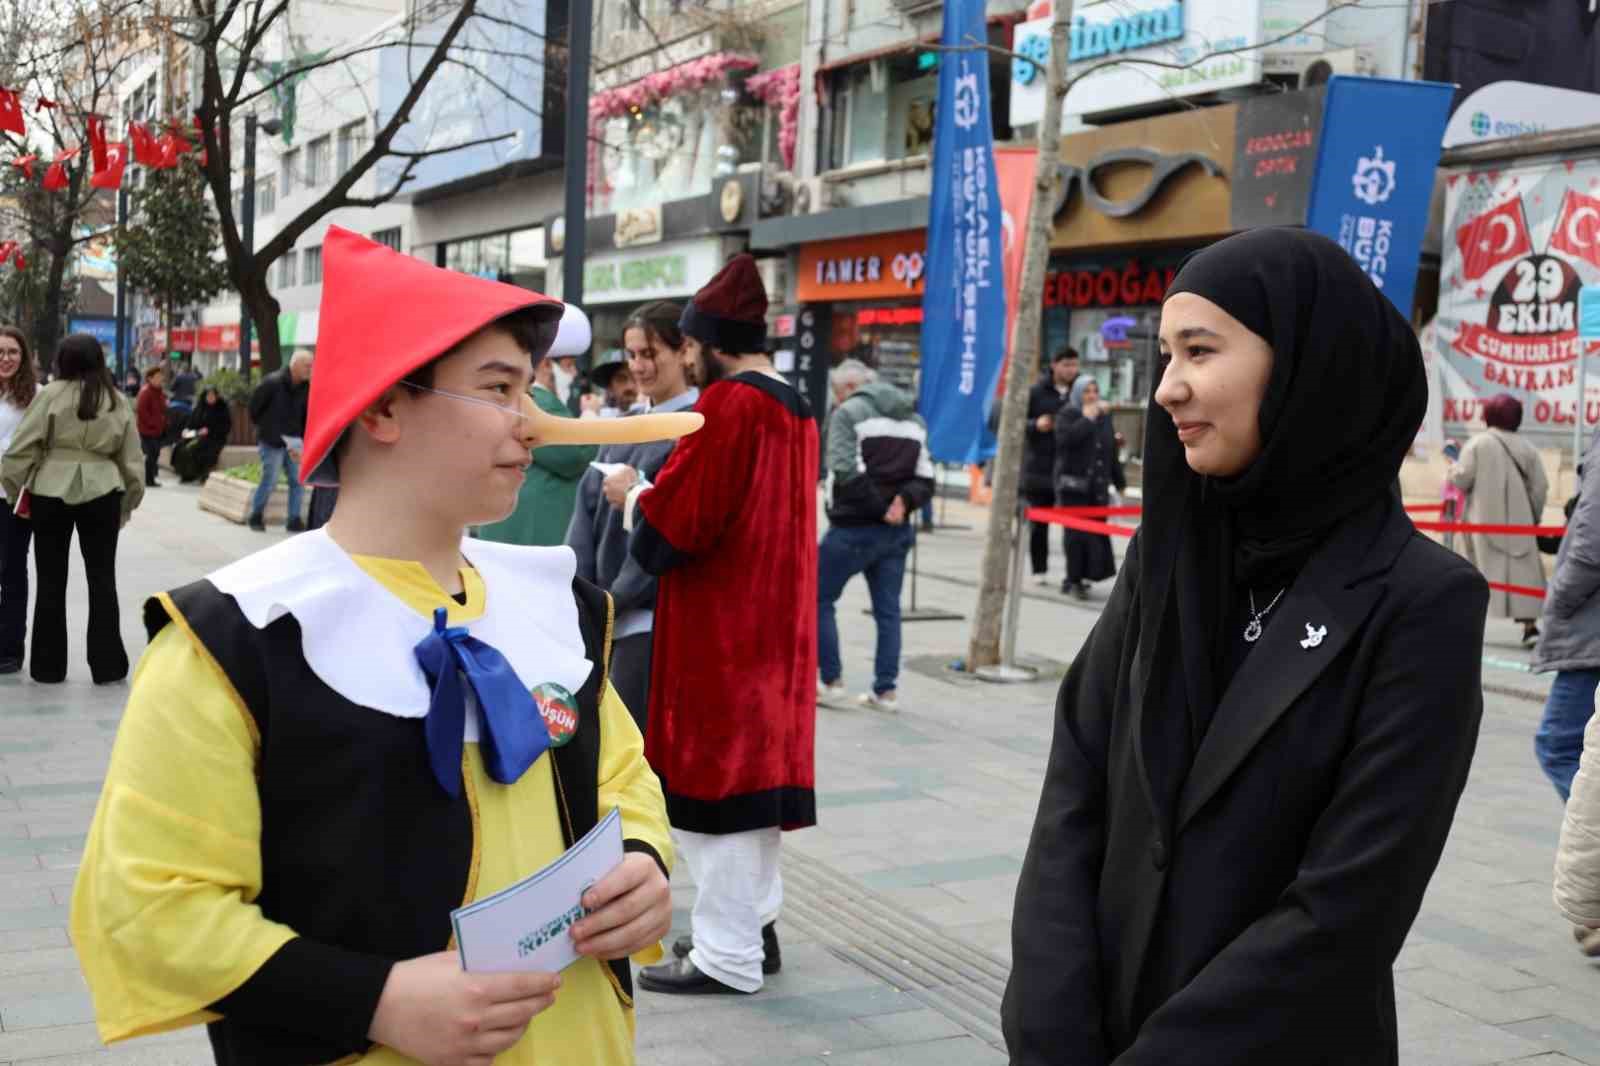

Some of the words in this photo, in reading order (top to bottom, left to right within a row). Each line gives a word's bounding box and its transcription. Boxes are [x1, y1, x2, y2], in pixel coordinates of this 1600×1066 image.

[1012, 2, 1184, 87] geinomi
[816, 256, 881, 285] TAMER
[1043, 258, 1175, 306] ERDOĞA
[1512, 258, 1564, 302] 29
[799, 311, 815, 396] GÖZL
[1477, 333, 1580, 363] CUMHURİYE
[1484, 362, 1575, 392] BAYRAM
[536, 698, 576, 731] ÜŞÜN
